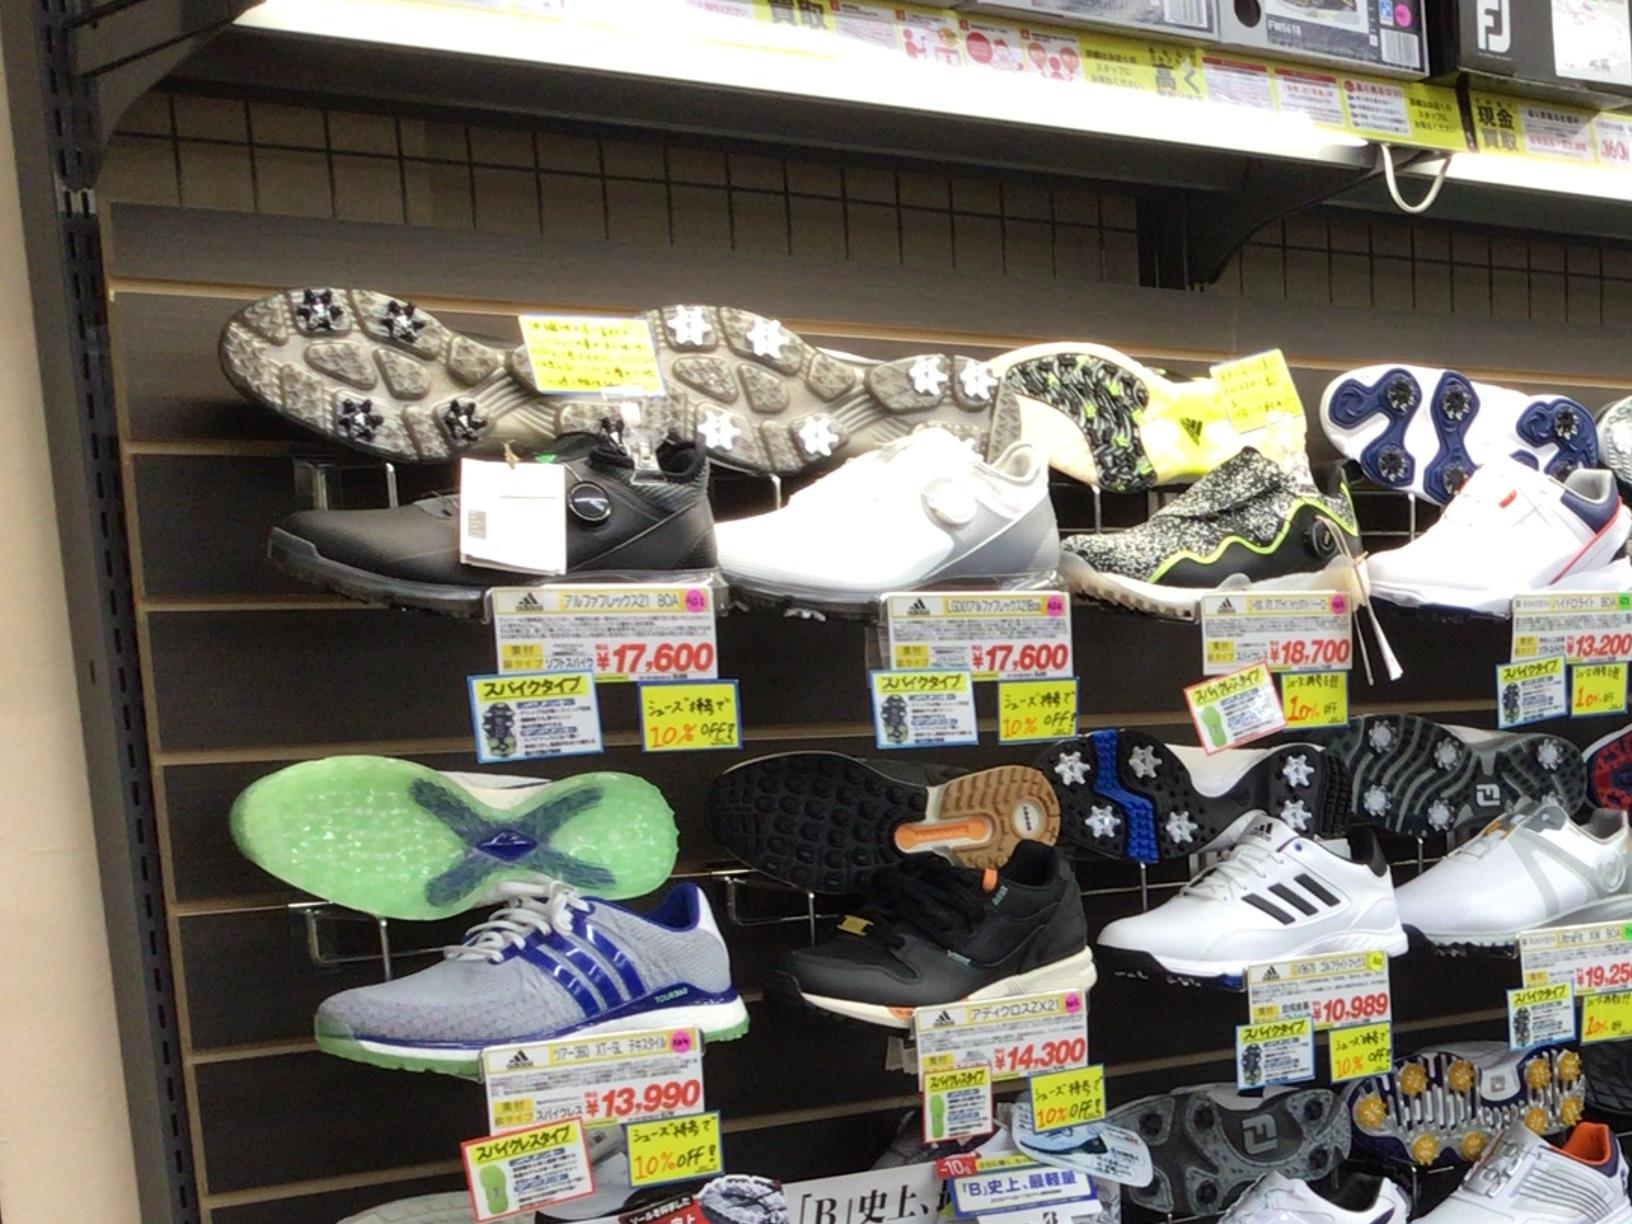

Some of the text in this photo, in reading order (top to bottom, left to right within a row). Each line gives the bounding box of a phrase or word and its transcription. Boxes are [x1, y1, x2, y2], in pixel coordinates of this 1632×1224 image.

[1477, 105, 1514, 129] 現金
[596, 641, 714, 674] ¥17,600
[972, 643, 1069, 671] ¥17,600
[1270, 640, 1351, 665] ¥18,700
[1566, 633, 1632, 658] ¥13,200
[483, 675, 583, 698] スパイクタイプ
[1312, 992, 1388, 1023] ¥10,989
[994, 1037, 1086, 1071] ¥14,300
[585, 1078, 702, 1119] ¥13,990
[476, 1124, 571, 1161] スパイクレスタイプ
[961, 1170, 1078, 1198] 「B」史上、最軽量
